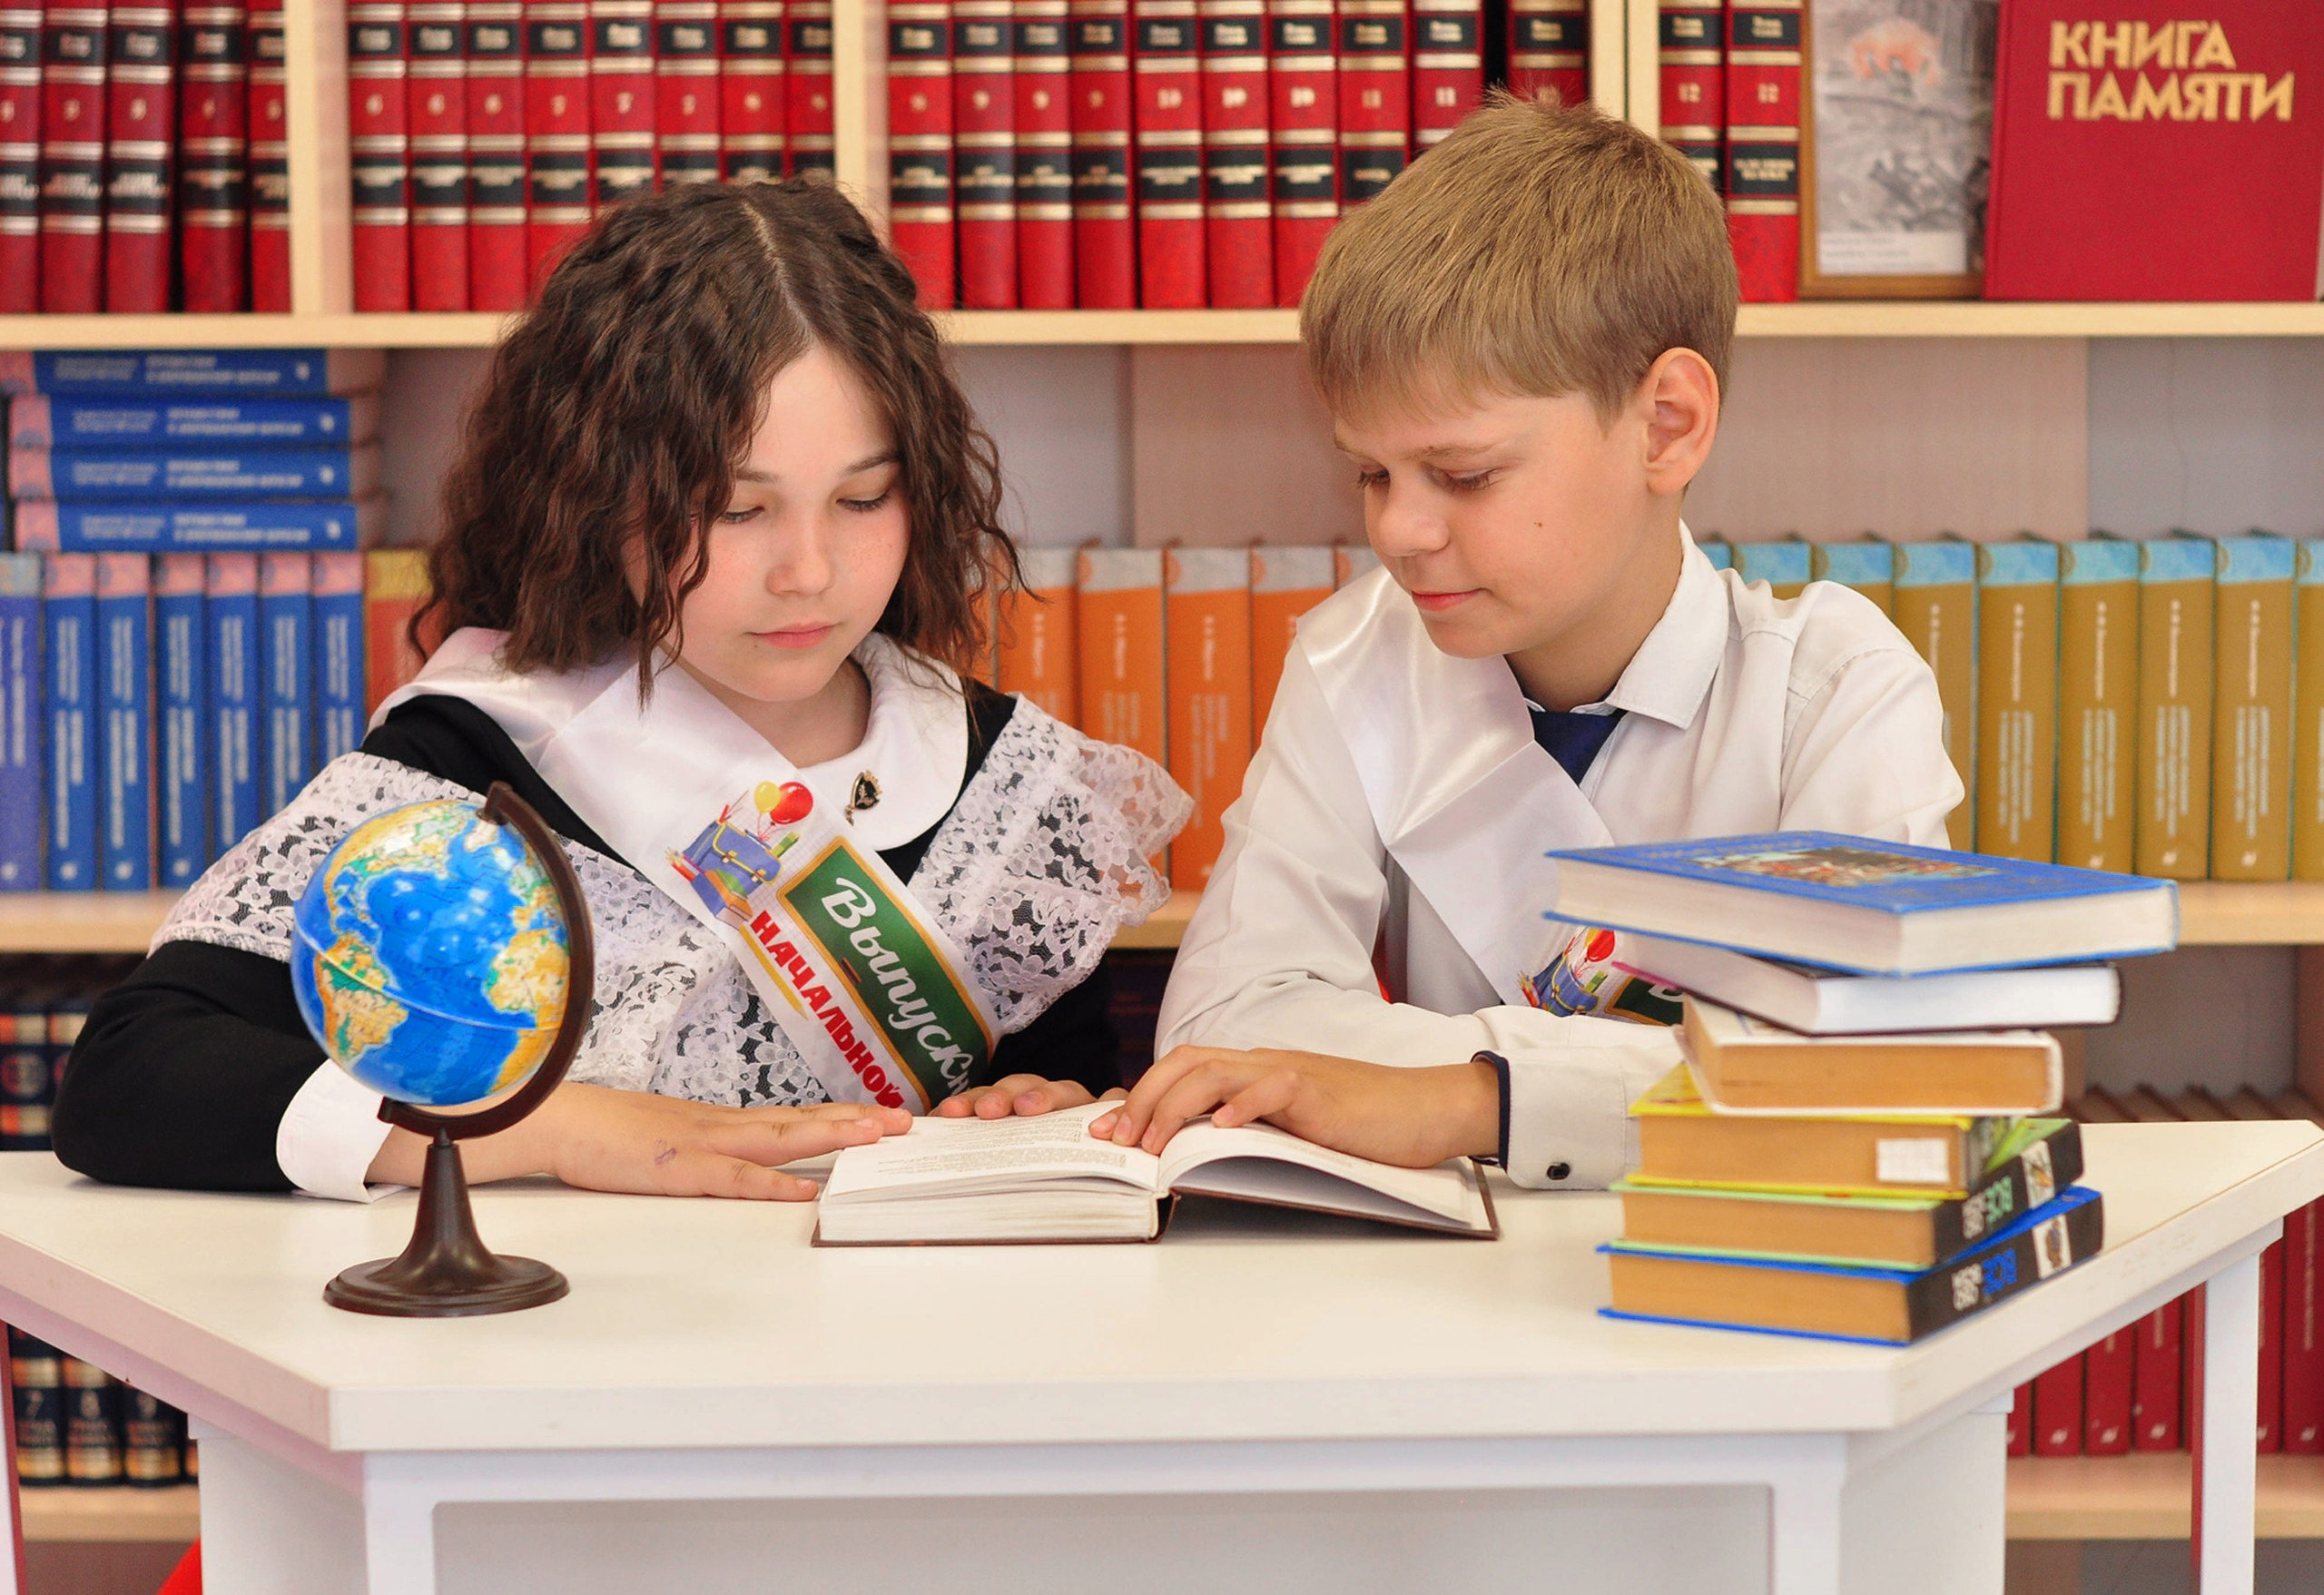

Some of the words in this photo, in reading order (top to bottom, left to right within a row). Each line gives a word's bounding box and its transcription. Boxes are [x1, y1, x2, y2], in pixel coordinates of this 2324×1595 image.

[2046, 71, 2295, 122] ПАМЯТИ
[2049, 20, 2238, 70] КНИГА
[750, 910, 905, 1109] НАЧАЛЬНОЙ
[822, 877, 974, 1097] Выпускн
